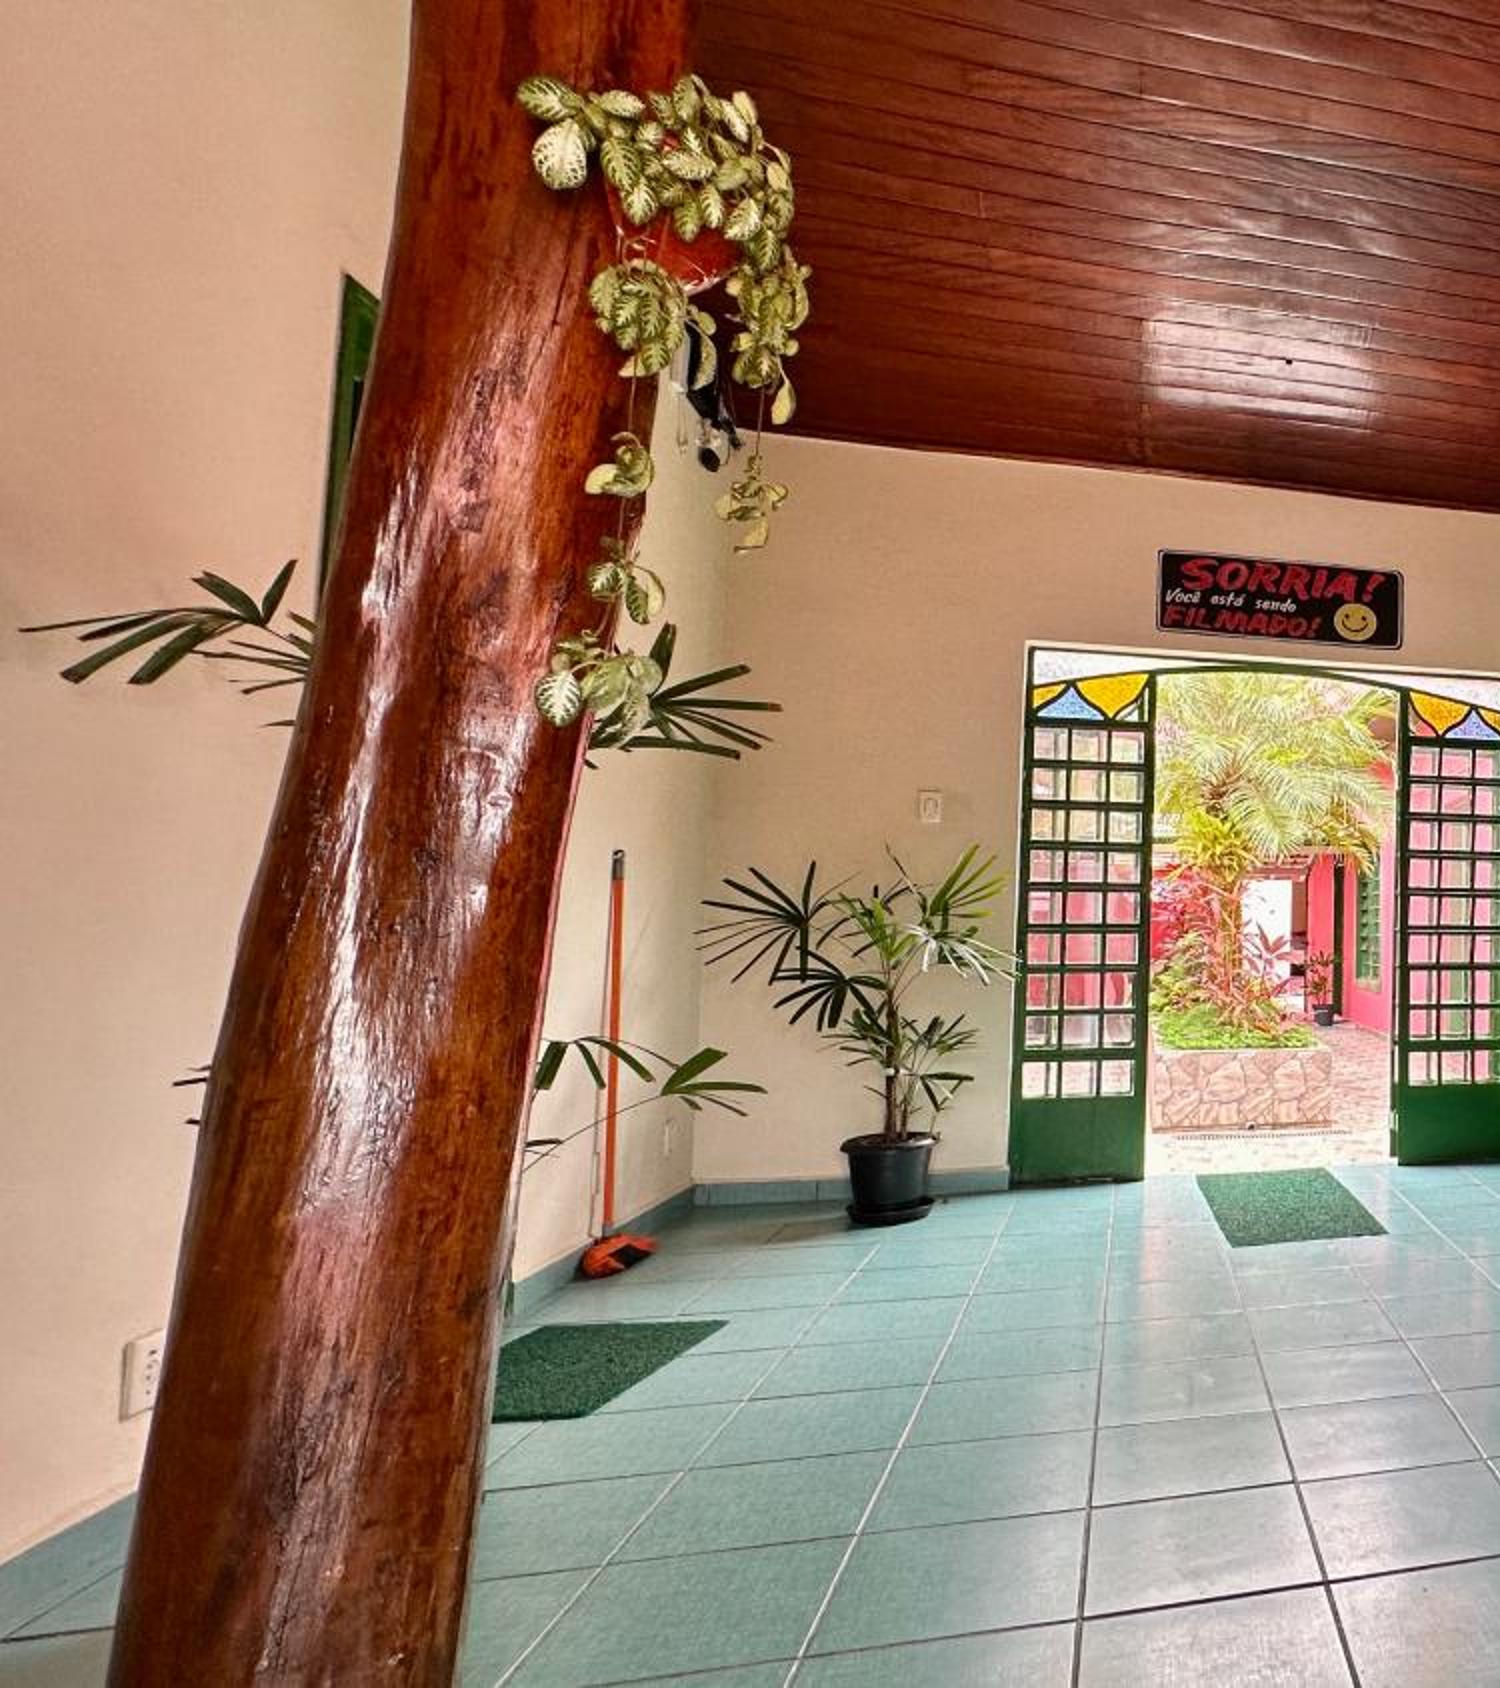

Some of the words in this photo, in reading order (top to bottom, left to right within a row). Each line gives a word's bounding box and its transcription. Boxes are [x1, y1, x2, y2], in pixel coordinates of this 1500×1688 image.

[1180, 557, 1386, 603] SORRIA!
[1165, 587, 1201, 604] Você
[1211, 591, 1246, 607] está
[1255, 598, 1297, 613] sendo
[1162, 603, 1323, 638] FILMADO!
